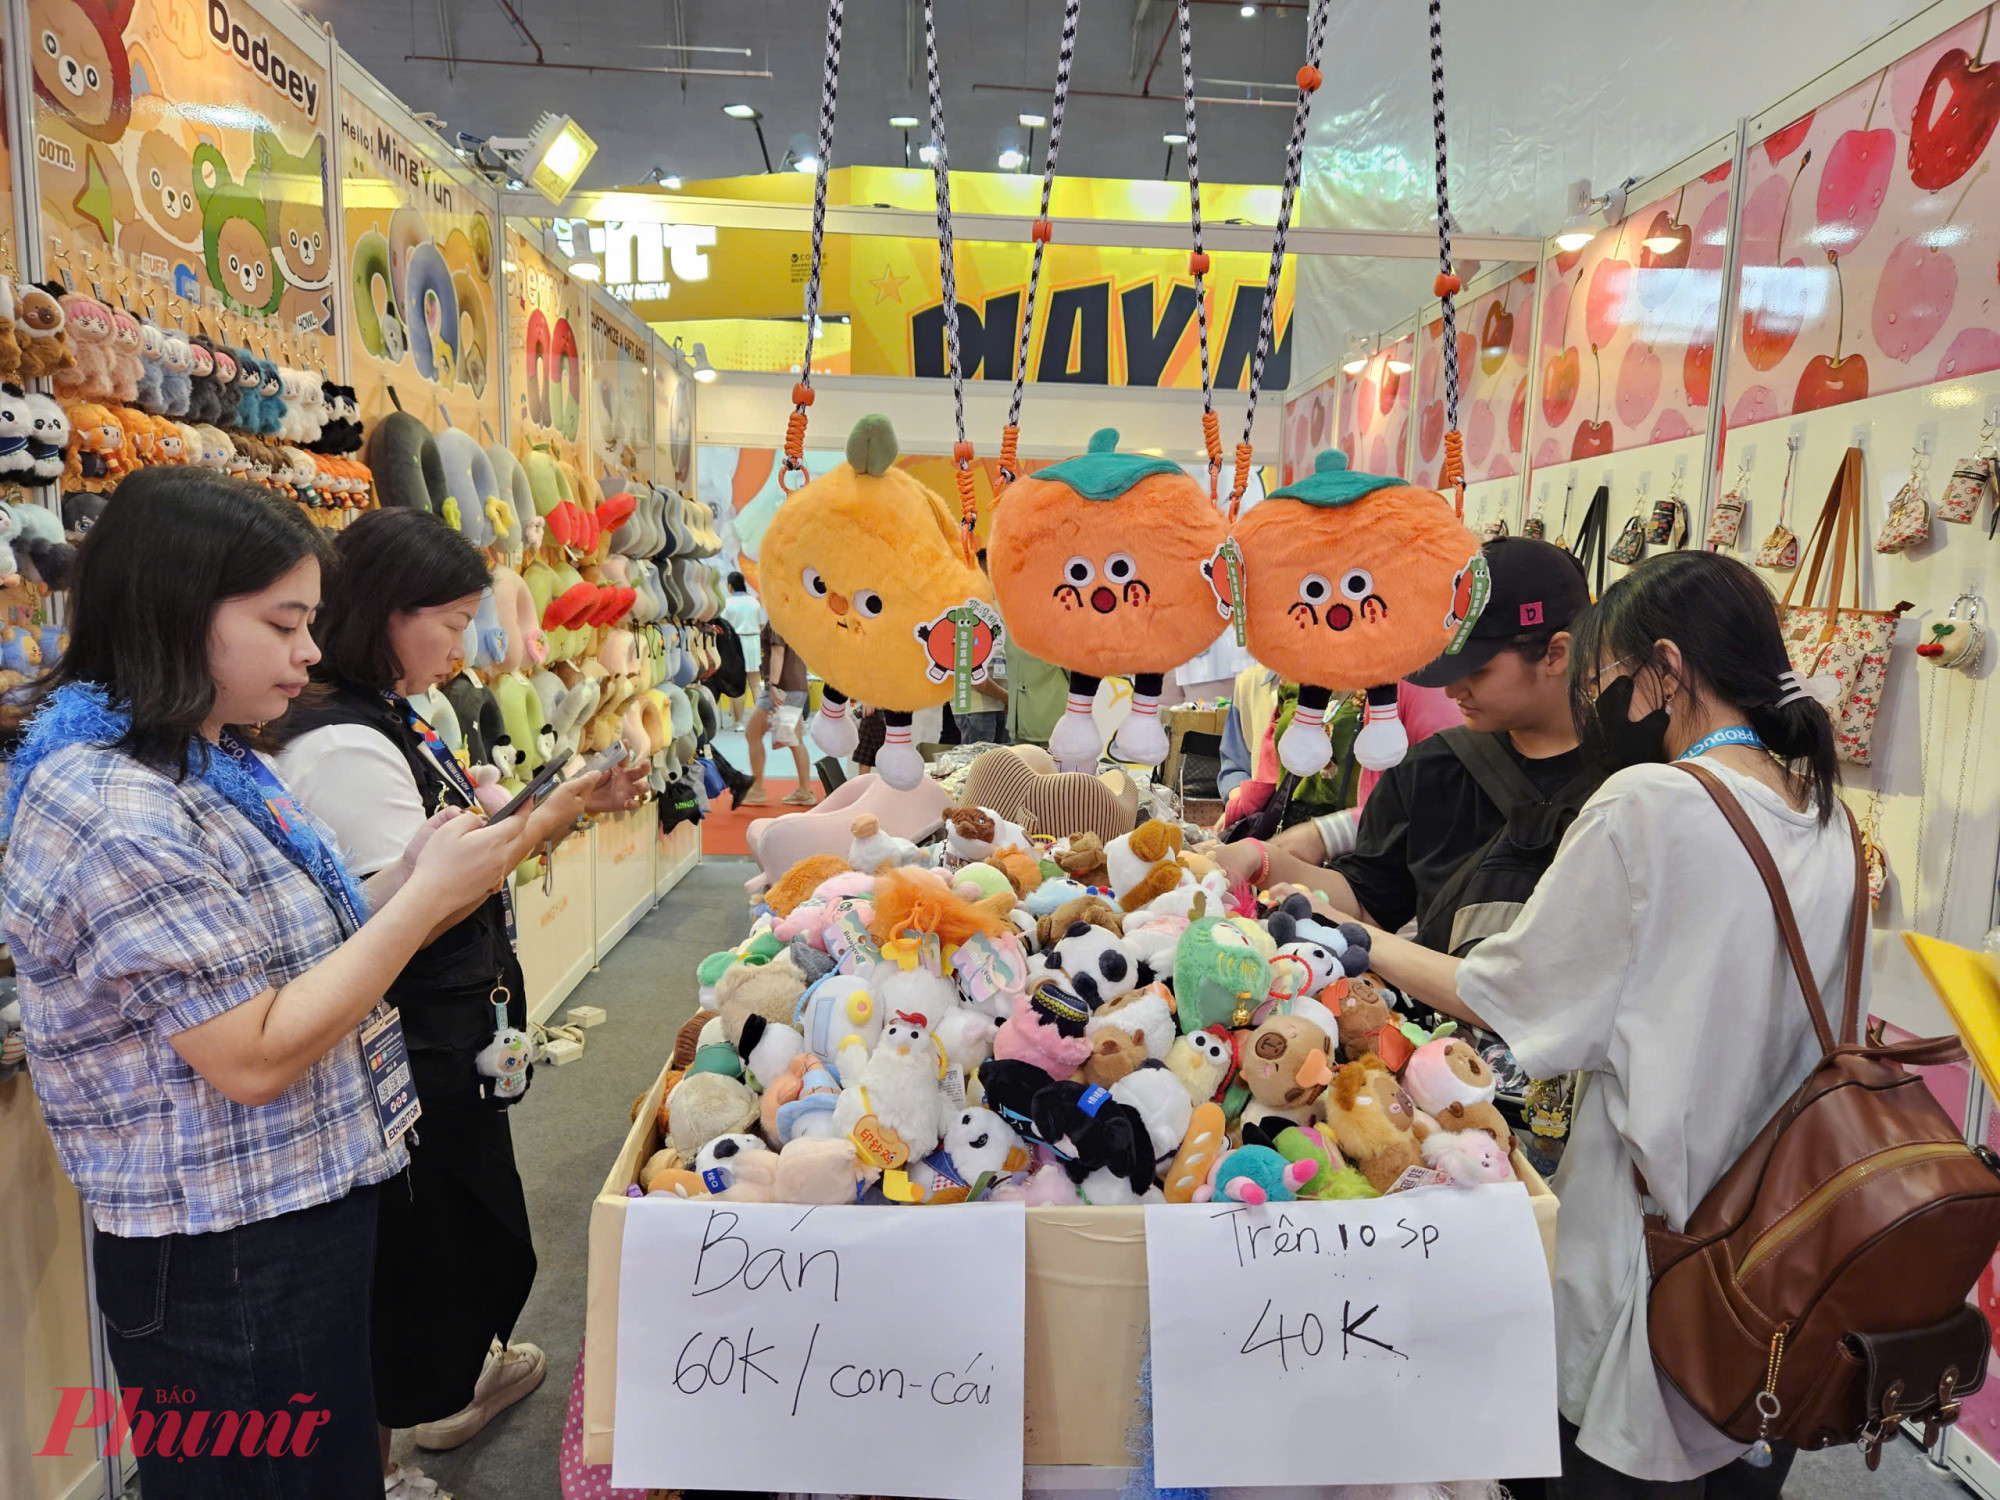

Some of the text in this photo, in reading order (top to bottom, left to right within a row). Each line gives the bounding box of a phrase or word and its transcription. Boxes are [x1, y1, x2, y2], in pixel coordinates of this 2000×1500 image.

[208, 0, 317, 116] Dodoey
[38, 137, 75, 169] OOTD.
[341, 114, 373, 154] Hello!
[591, 310, 619, 347] CUSTOMIZE
[625, 336, 635, 357] GIFT
[387, 1104, 419, 1141] EXHIBITOR
[691, 1204, 840, 1302] Bán
[1210, 1208, 1320, 1267] Trên
[1338, 1223, 1377, 1251] 10
